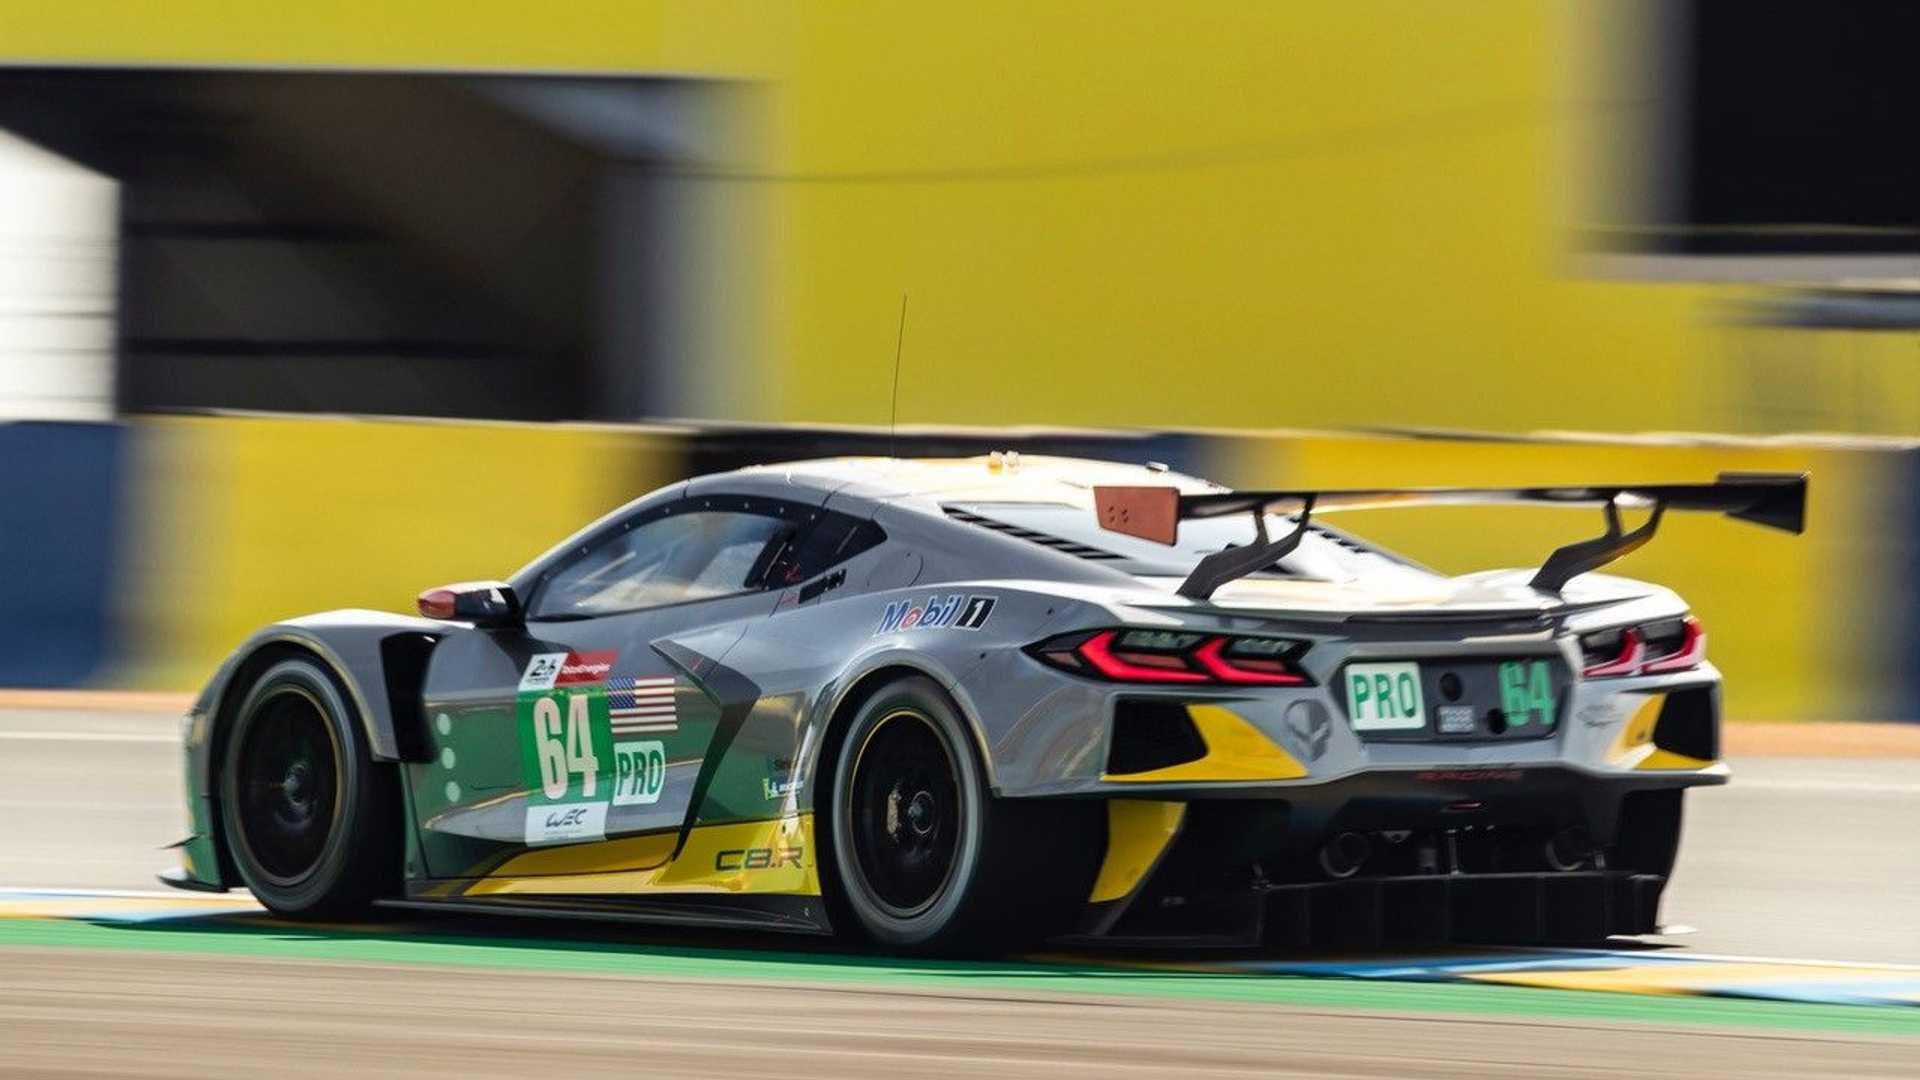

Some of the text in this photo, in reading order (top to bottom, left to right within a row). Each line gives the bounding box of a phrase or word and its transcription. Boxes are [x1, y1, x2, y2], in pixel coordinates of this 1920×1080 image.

[876, 595, 963, 633] Mobil
[1352, 672, 1416, 719] PRO
[1499, 659, 1556, 727] 64
[533, 694, 599, 800] 64
[617, 750, 663, 796] PRO
[545, 809, 588, 828] WEC
